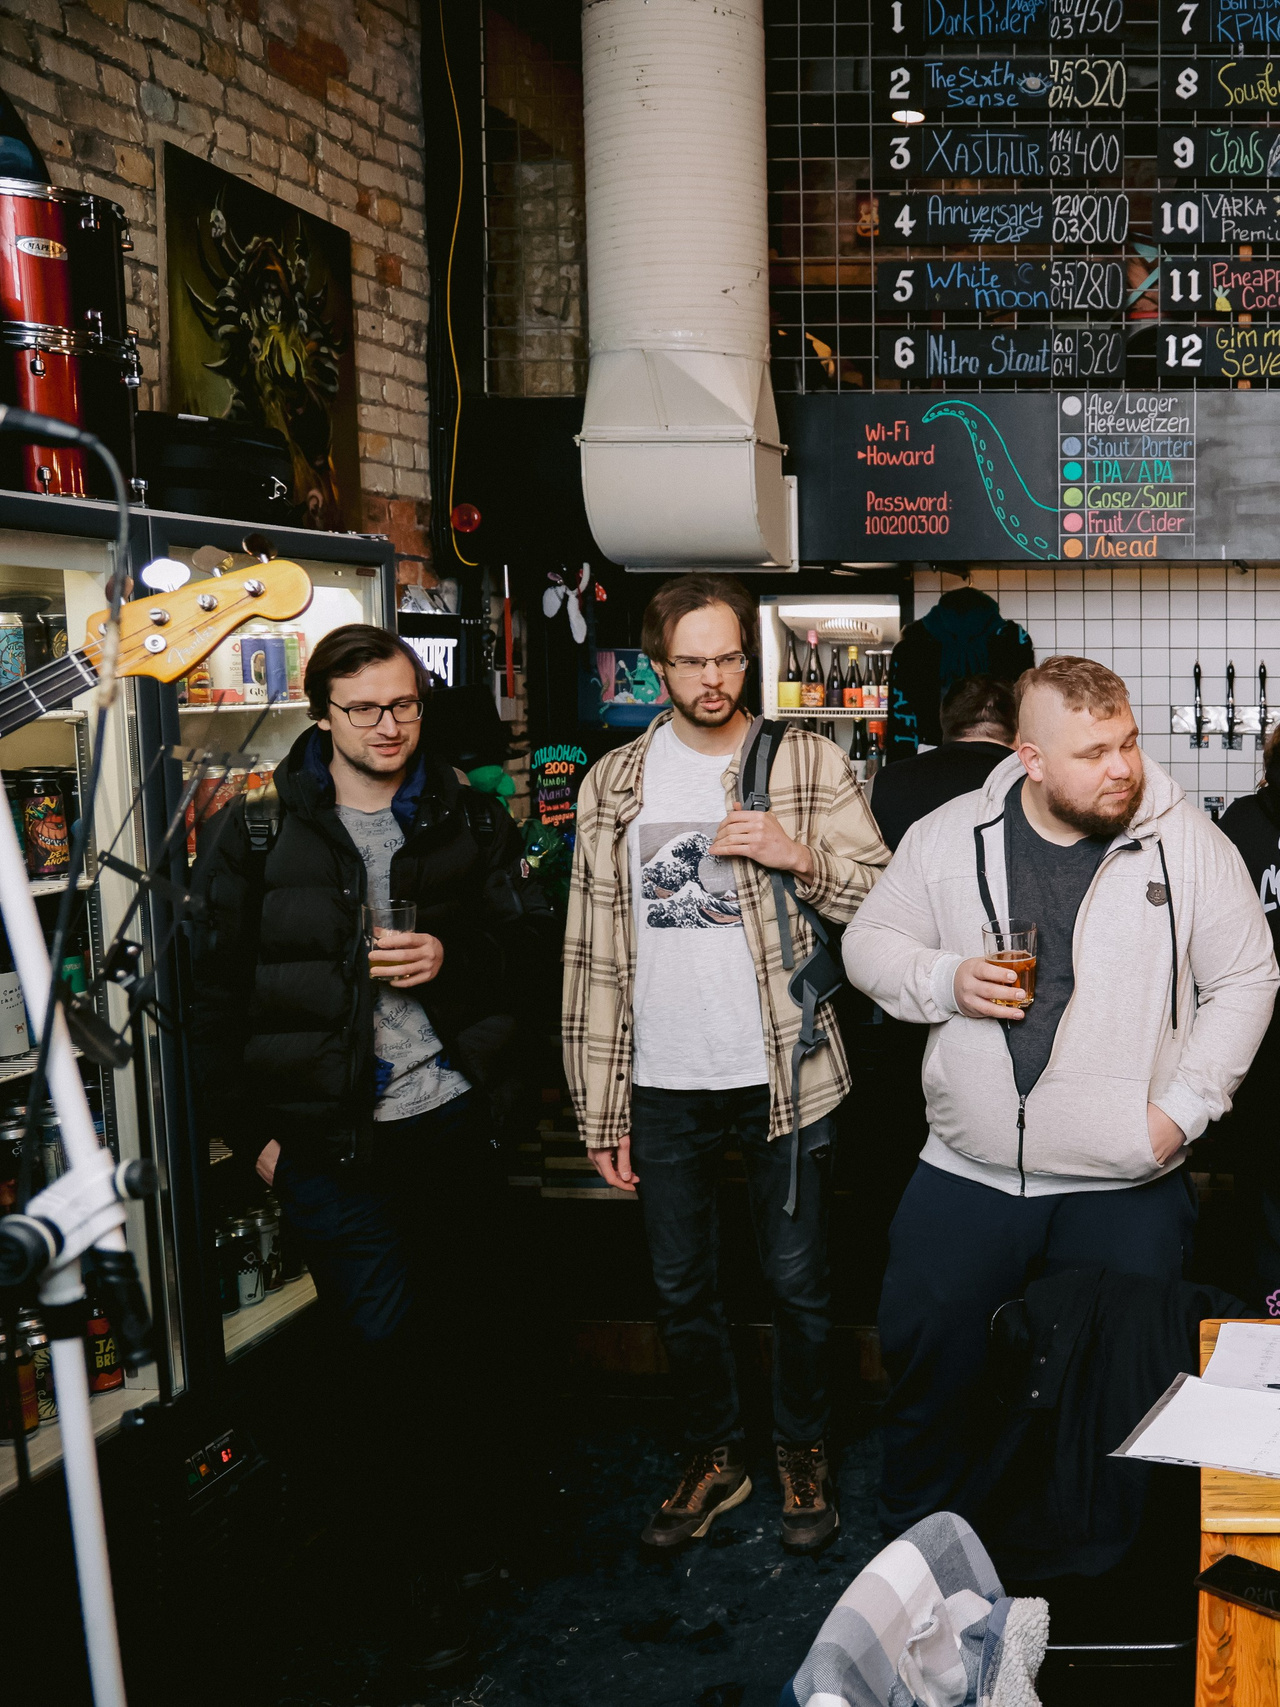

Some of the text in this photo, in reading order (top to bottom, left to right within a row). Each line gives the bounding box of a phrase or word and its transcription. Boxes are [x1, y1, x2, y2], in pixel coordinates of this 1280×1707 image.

[891, 0, 907, 34] 1
[1177, 3, 1199, 35] 7
[889, 67, 911, 100] 2
[1075, 59, 1127, 109] 320
[947, 88, 1020, 108] Sense
[1175, 67, 1199, 99] 8
[890, 131, 1120, 175] 3 400
[1173, 136, 1195, 169] 9
[894, 194, 1129, 244] 4 Anniversary 800
[1161, 201, 1199, 235] 10
[893, 261, 1123, 309] 5 White 280
[975, 288, 1048, 309] moon
[1169, 268, 1202, 303] 11
[894, 336, 915, 369] 6
[930, 334, 980, 376] Nitro
[1079, 331, 1122, 376] 320
[1165, 333, 1203, 367] 12
[865, 420, 911, 442] Wi-Fi
[866, 444, 935, 466] Howard
[866, 490, 954, 514] Password:
[865, 515, 950, 535] 100200300
[1091, 535, 1158, 560] Mead
